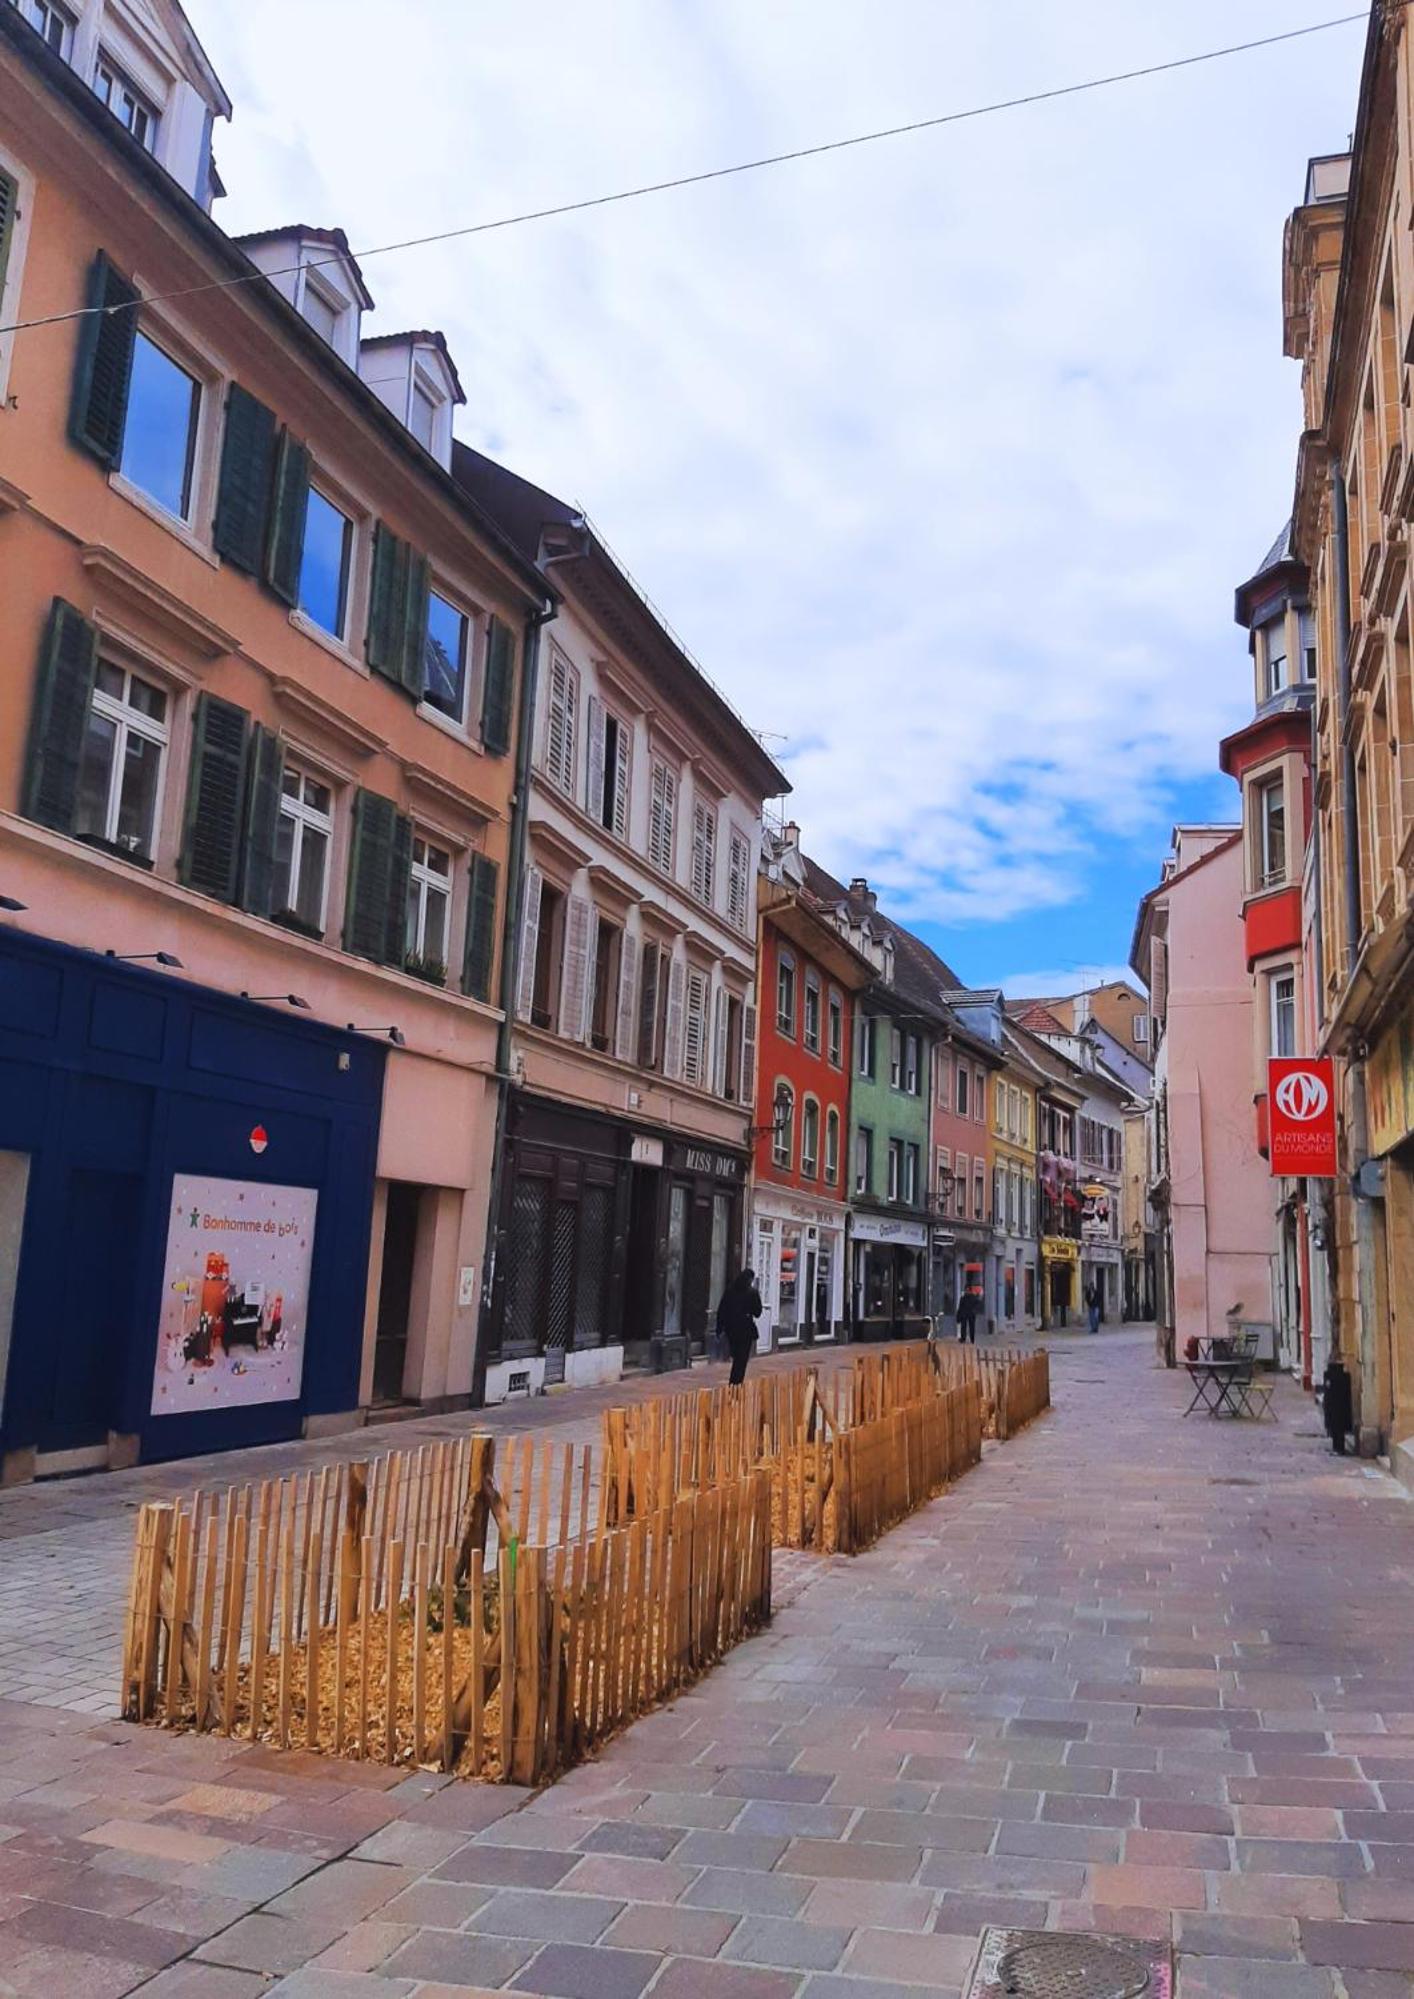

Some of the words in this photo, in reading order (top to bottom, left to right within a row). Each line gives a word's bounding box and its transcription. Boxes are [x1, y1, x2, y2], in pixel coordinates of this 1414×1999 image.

[1275, 1132, 1333, 1143] ARTISANS
[1274, 1143, 1291, 1154] DU
[1291, 1143, 1333, 1154] MONDE
[685, 1148, 712, 1173] MISS
[203, 1214, 262, 1232] Bonhomme
[263, 1219, 276, 1233] de
[278, 1217, 299, 1237] bois
